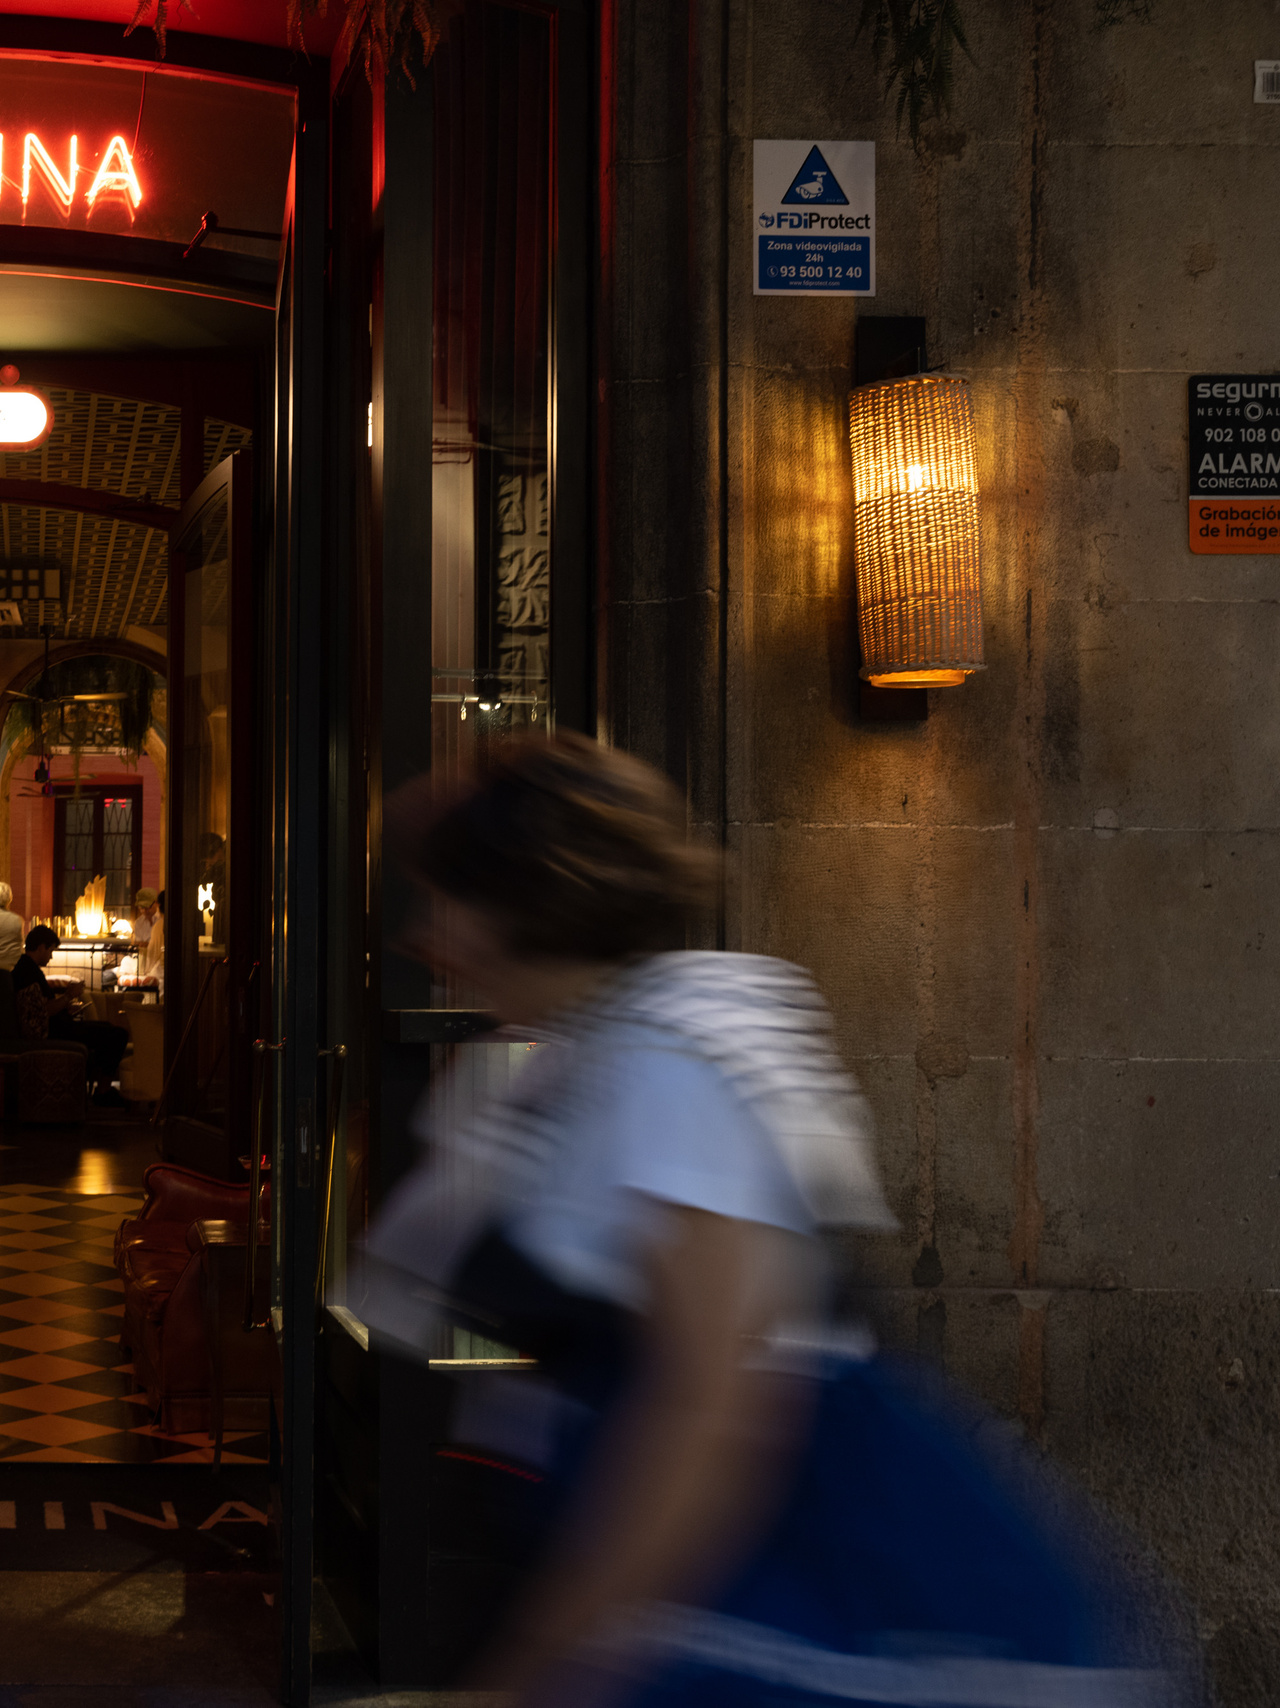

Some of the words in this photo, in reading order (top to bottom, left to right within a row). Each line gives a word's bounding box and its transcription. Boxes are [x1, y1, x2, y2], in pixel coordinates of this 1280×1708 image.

[776, 212, 871, 229] FDiProtect
[767, 241, 793, 251] Zona
[795, 241, 862, 253] videovigilada
[805, 253, 824, 263] 24h
[780, 265, 796, 277] 93
[799, 266, 823, 278] 500
[827, 266, 843, 278] 12
[845, 267, 862, 278] 40
[1197, 407, 1240, 416] NEVER
[1204, 428, 1233, 442] 902
[1239, 428, 1266, 442] 108
[1198, 477, 1278, 488] CONECTADA
[1199, 505, 1280, 521] Grabació
[1199, 524, 1220, 537] de
[1226, 522, 1280, 541] imáge
